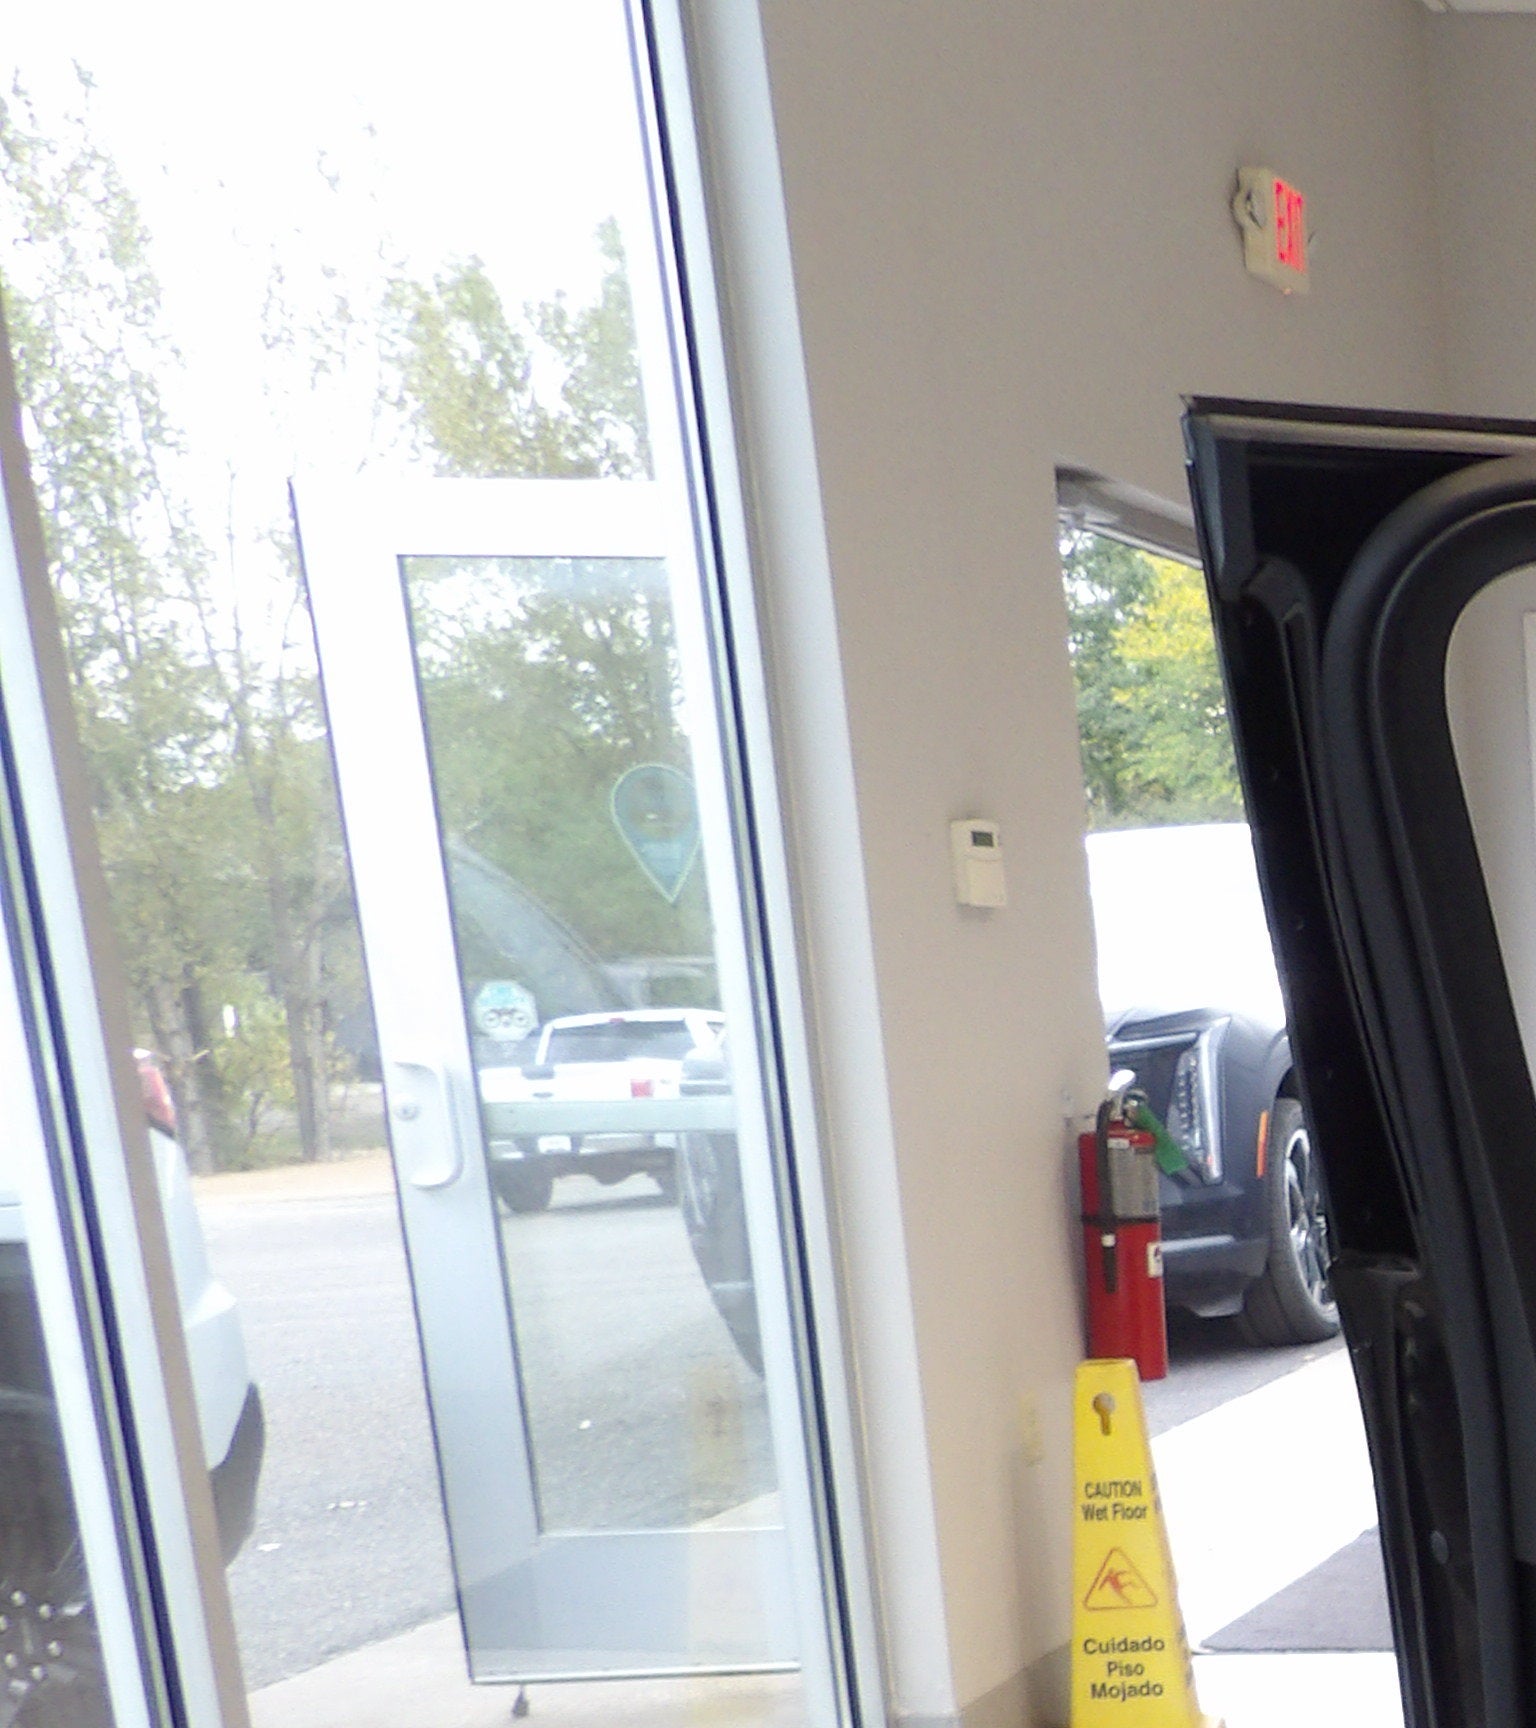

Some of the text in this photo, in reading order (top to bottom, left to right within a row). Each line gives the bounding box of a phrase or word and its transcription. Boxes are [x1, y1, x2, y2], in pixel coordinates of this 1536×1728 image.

[1085, 1481, 1142, 1499] CAUTION
[1082, 1503, 1147, 1521] Wet Floor
[1083, 1636, 1165, 1654] Cuidado
[1107, 1661, 1145, 1677] Piso
[1091, 1680, 1163, 1702] Mojado
